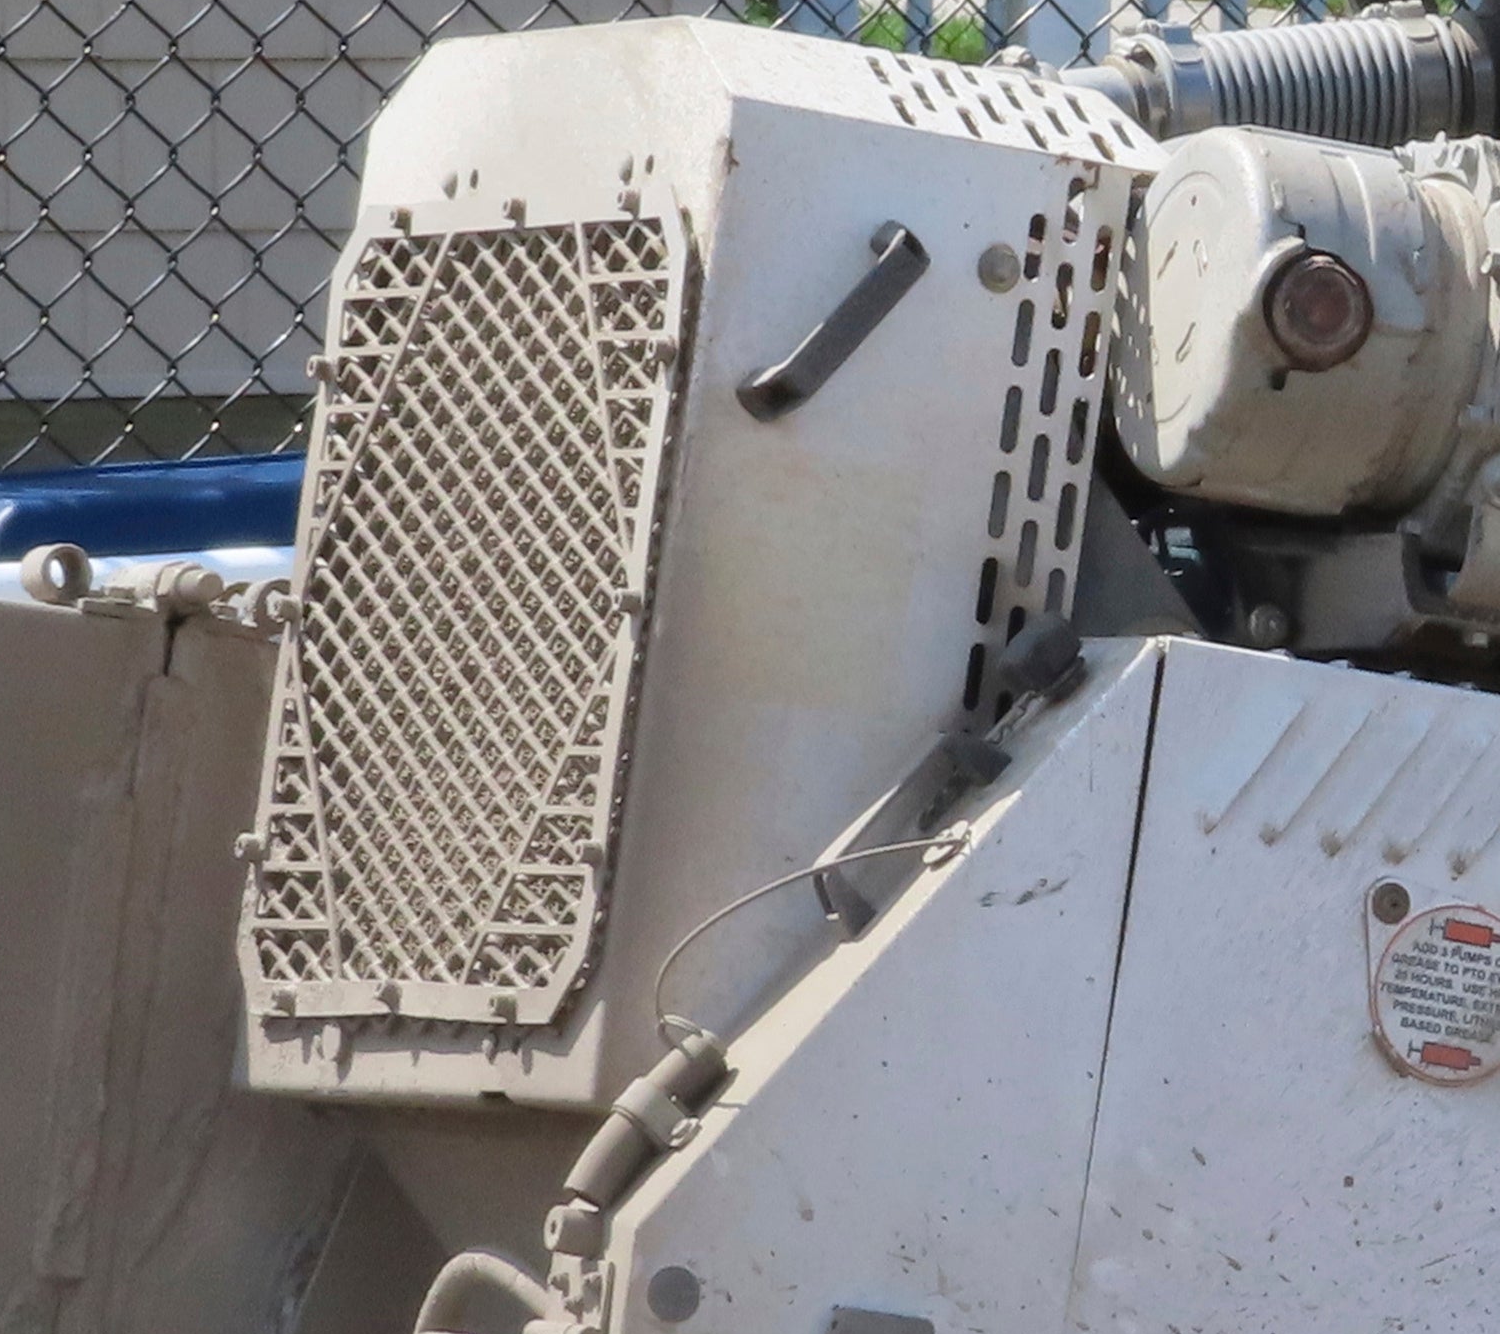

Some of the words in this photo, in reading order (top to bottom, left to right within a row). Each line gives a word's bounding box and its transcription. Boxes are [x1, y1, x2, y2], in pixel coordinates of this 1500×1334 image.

[1413, 941, 1438, 954] ADD
[1451, 946, 1492, 966] PUMPS
[1443, 962, 1459, 975] TO
[1462, 966, 1485, 980] PTO
[1400, 1016, 1442, 1034] BASED
